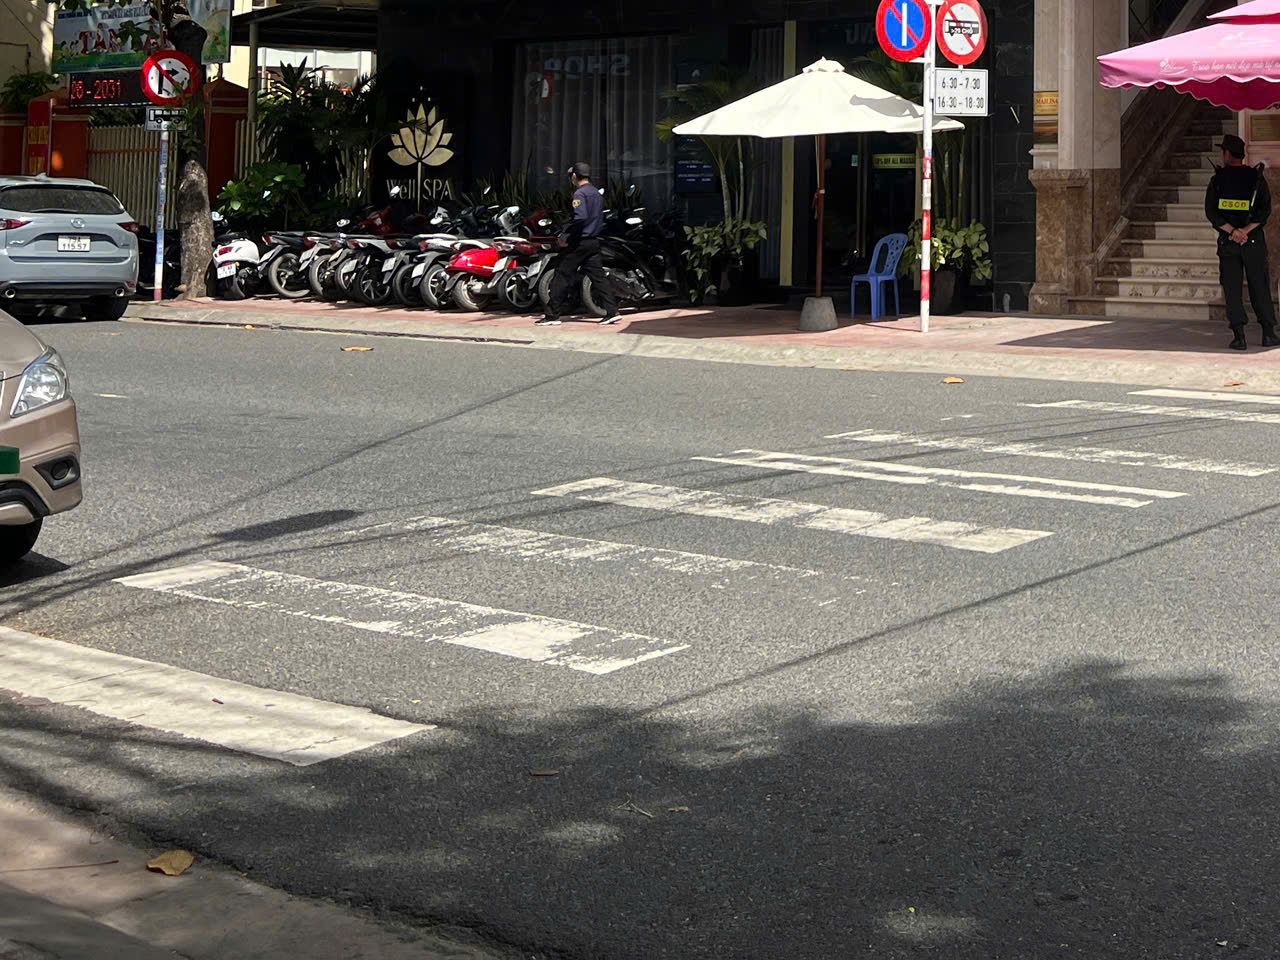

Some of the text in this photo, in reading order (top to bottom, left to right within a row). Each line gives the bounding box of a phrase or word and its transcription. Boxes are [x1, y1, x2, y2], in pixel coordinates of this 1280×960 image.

[941, 77, 958, 89] 6:30
[965, 78, 980, 89] 7:30
[938, 96, 957, 108] 16:30
[965, 96, 984, 109] 18:30
[386, 178, 453, 201] Well SPA
